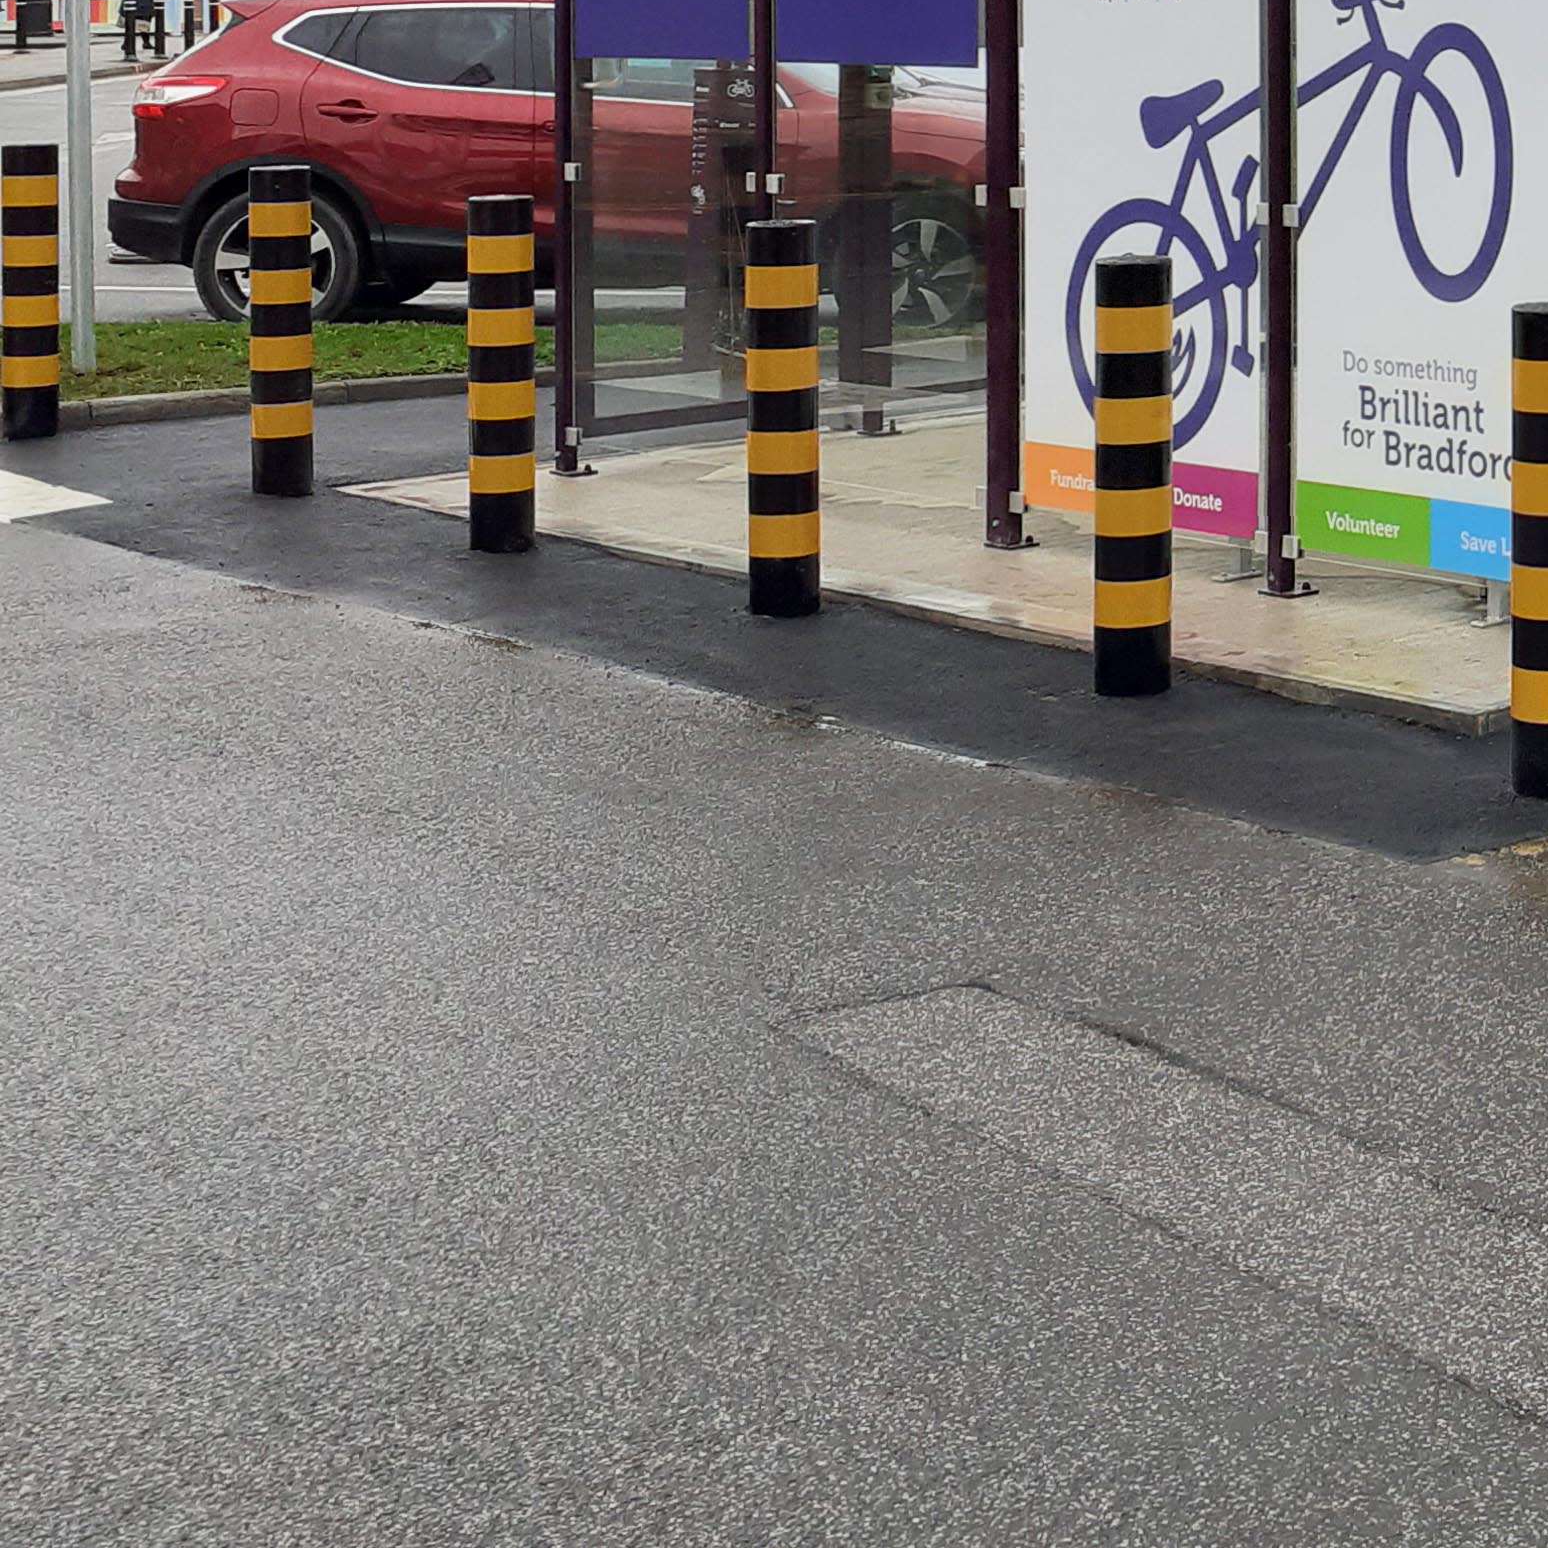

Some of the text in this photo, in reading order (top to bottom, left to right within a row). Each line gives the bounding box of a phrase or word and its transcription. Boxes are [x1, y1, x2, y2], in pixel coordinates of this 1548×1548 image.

[1343, 350, 1478, 391] Do something
[1358, 384, 1485, 434] Brilliant
[1342, 420, 1375, 450] for
[1050, 468, 1096, 492] Fundra
[1173, 487, 1223, 512] Donate
[1326, 510, 1400, 539] Volunteer
[1460, 530, 1497, 554] Save
